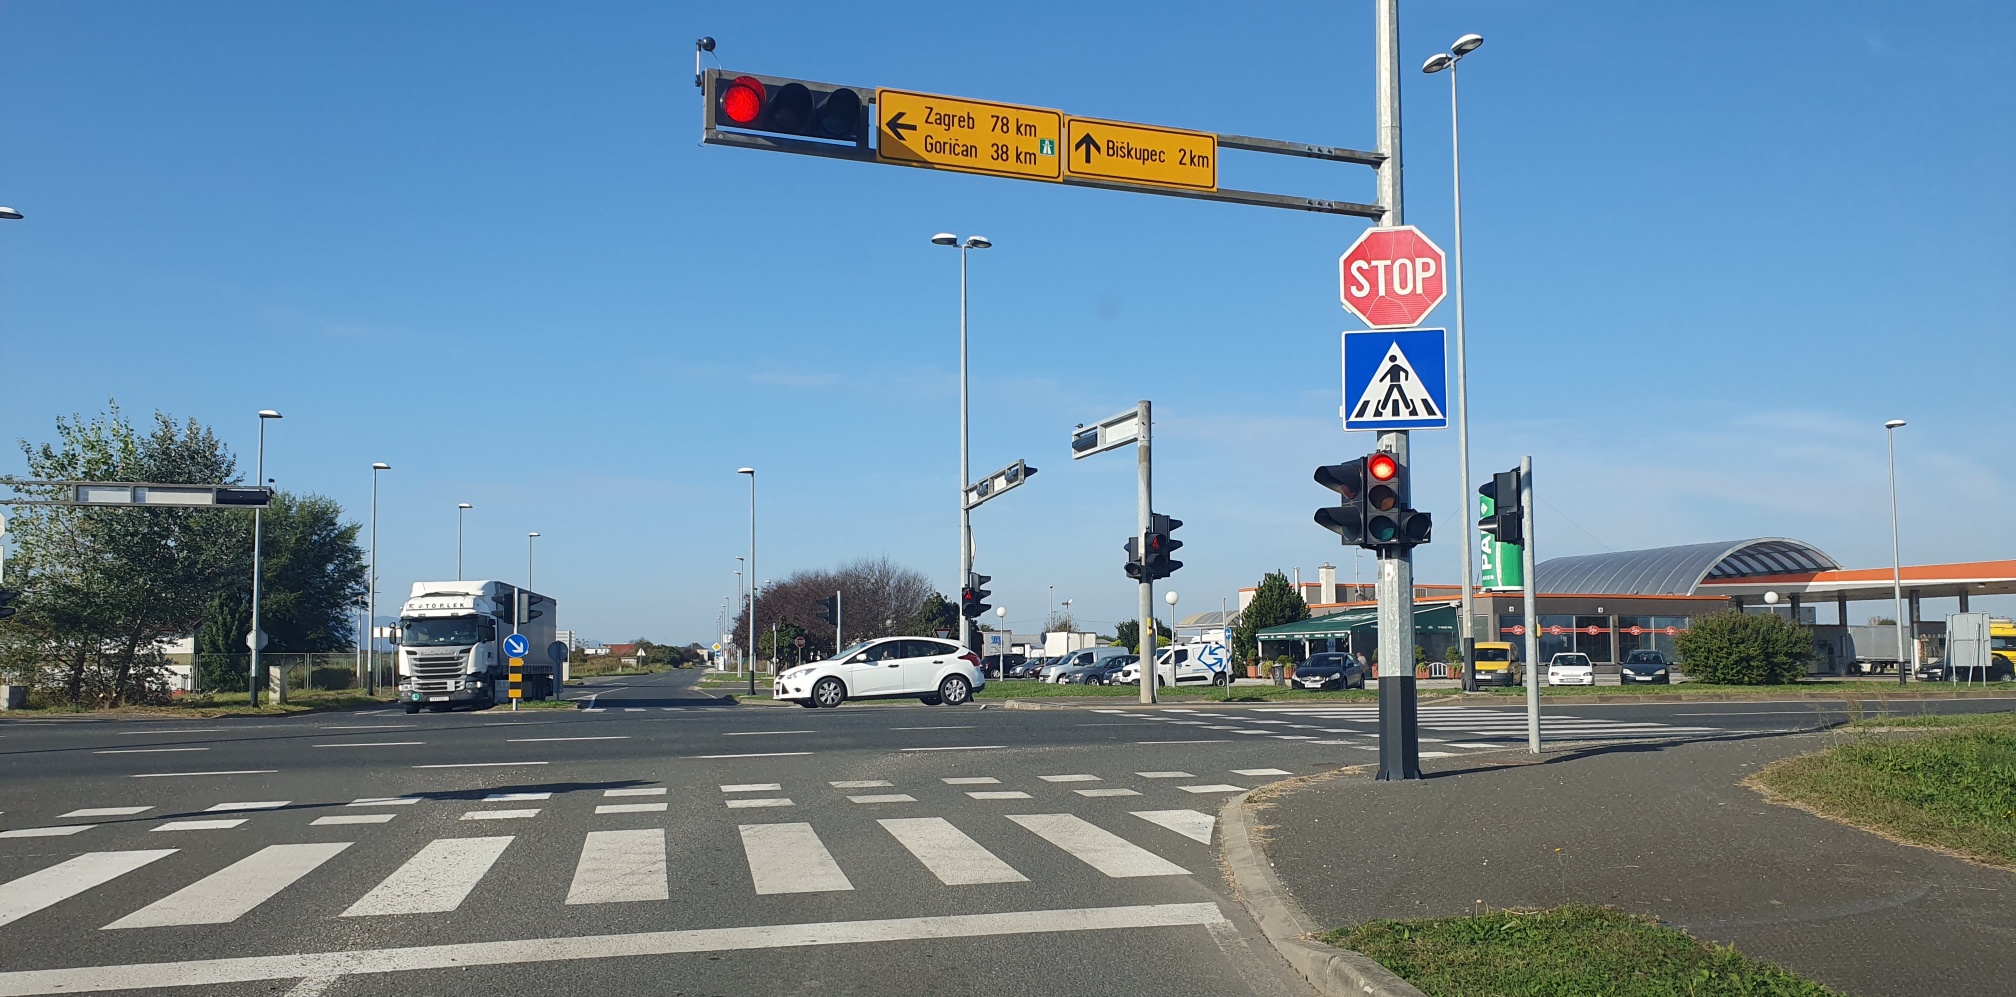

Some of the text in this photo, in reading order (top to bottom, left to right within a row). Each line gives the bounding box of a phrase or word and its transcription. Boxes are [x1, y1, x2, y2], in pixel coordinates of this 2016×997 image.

[924, 105, 1037, 138] Zagreb 78 km
[924, 134, 1037, 166] Goričan 38 km
[1106, 139, 1210, 169] Biškupec 2 km
[1350, 258, 1436, 298] STOP
[1481, 531, 1492, 570] PA
